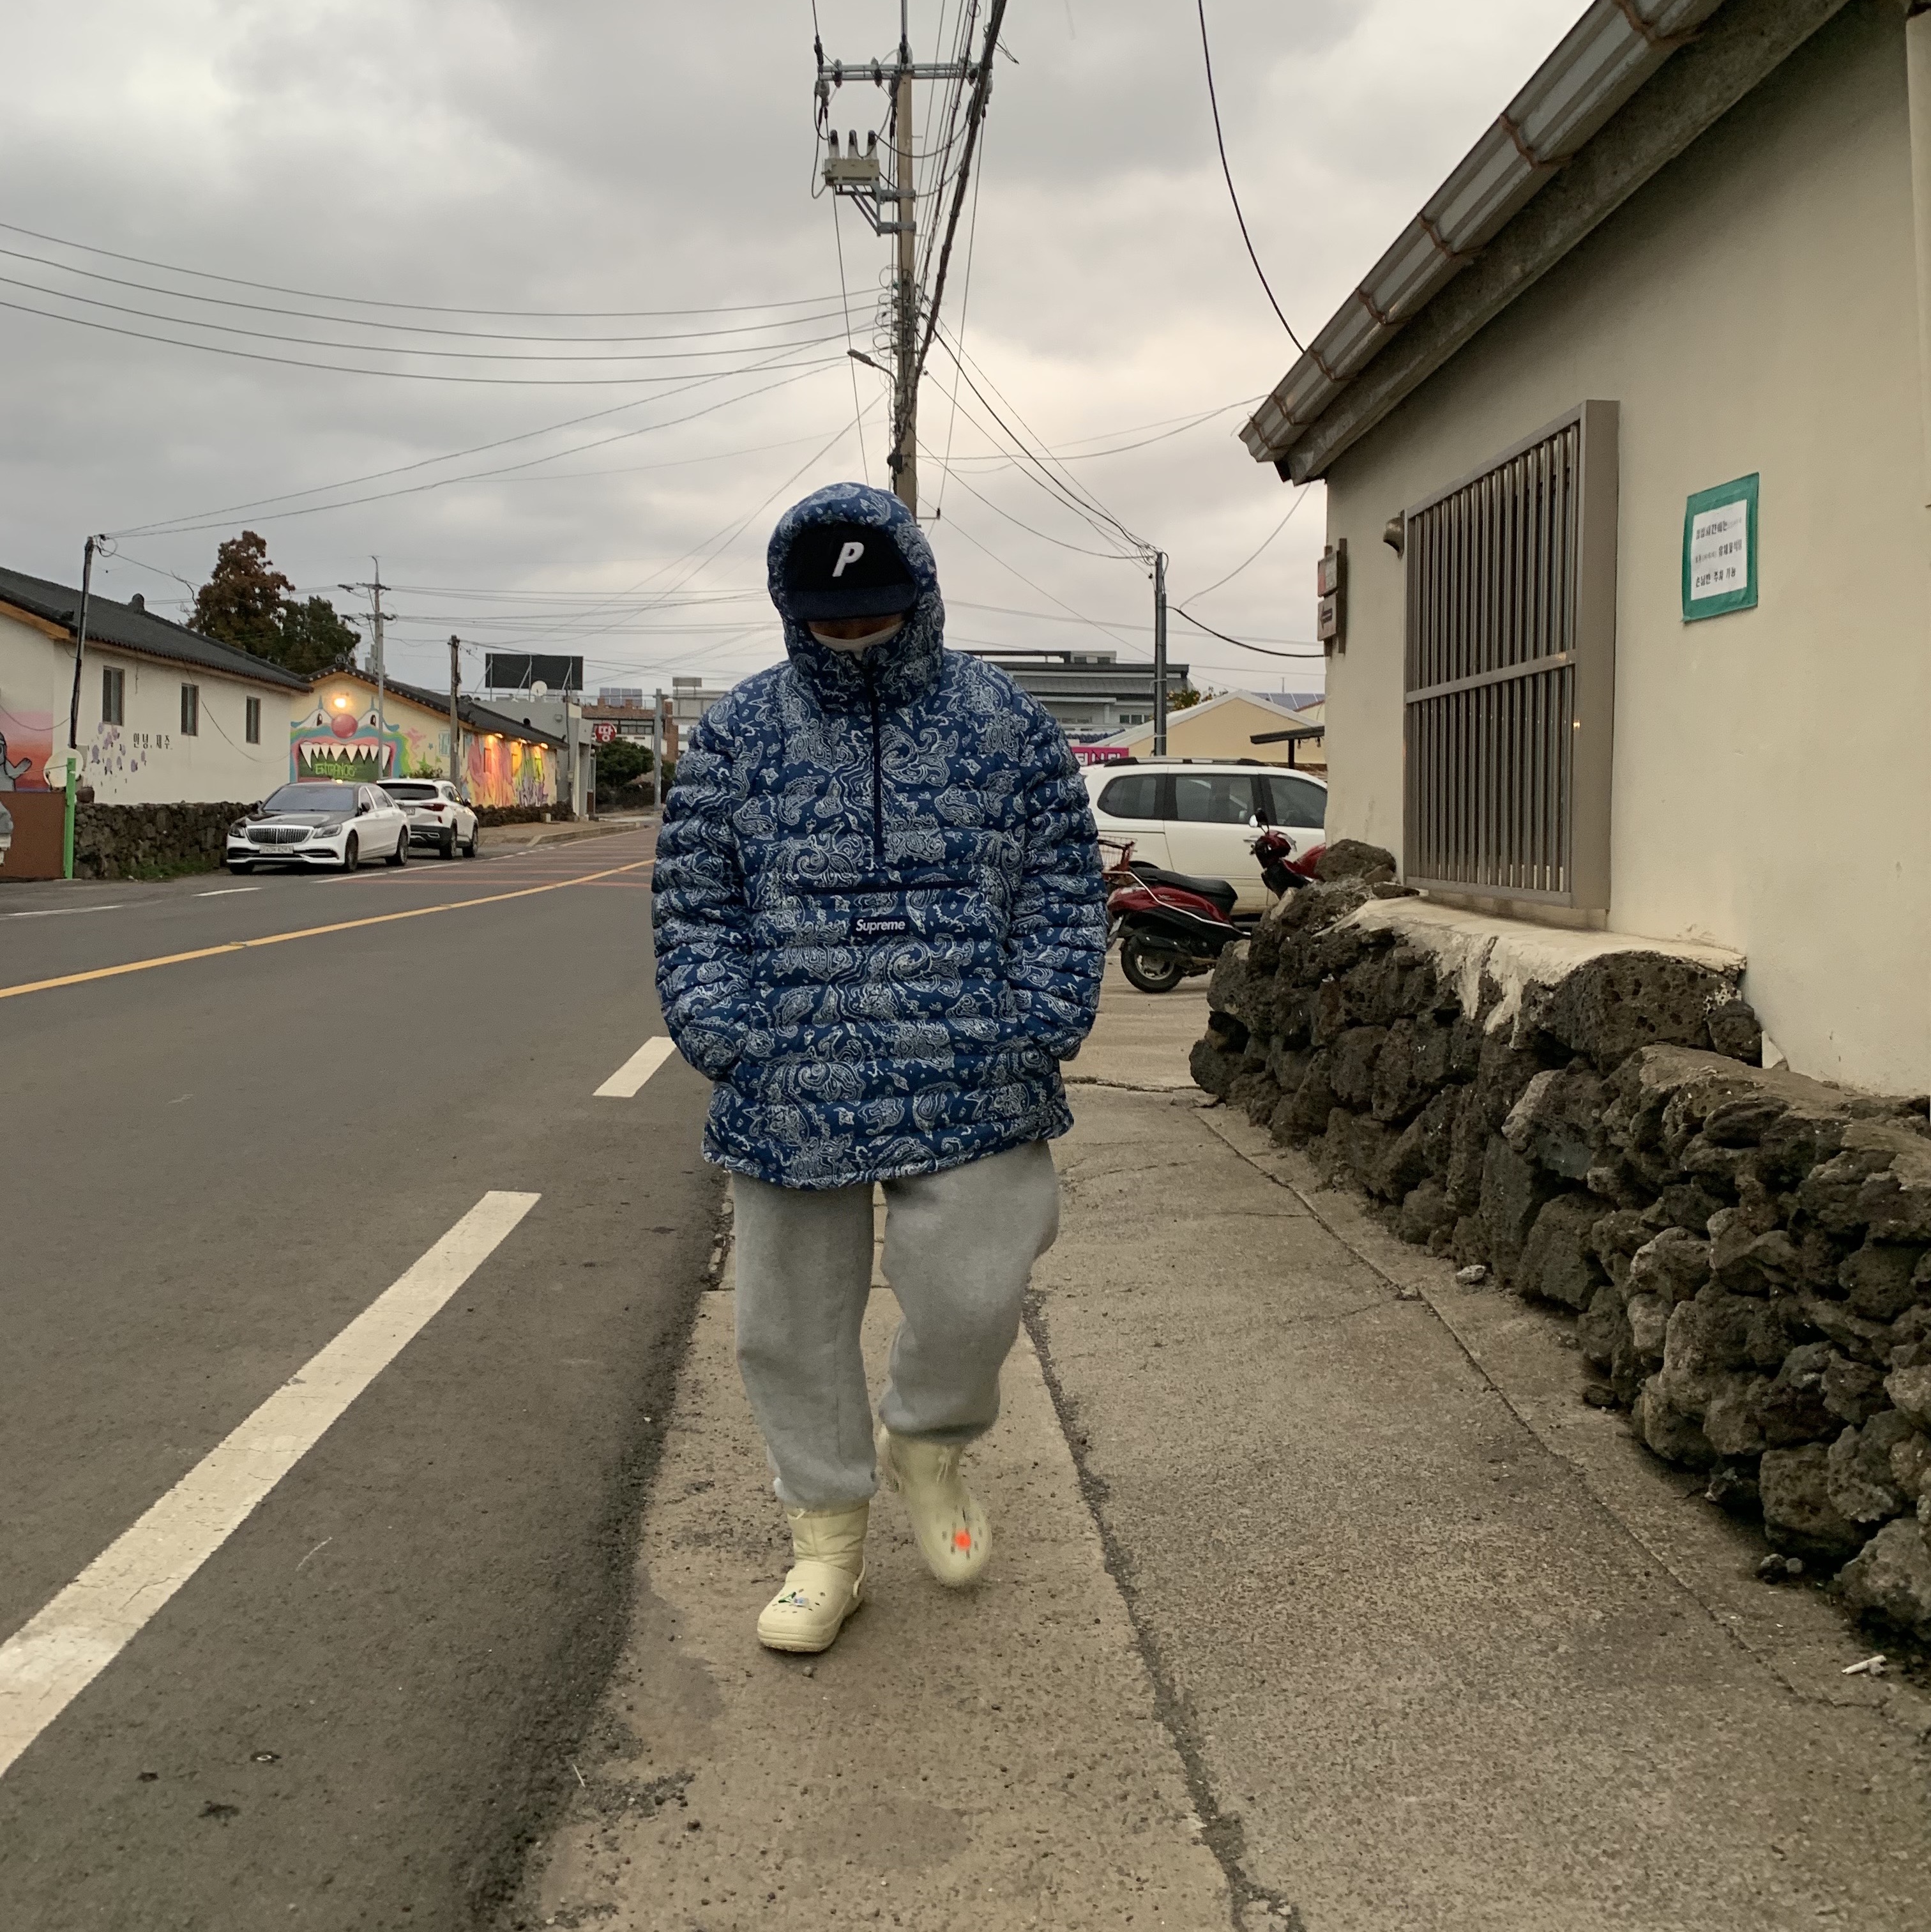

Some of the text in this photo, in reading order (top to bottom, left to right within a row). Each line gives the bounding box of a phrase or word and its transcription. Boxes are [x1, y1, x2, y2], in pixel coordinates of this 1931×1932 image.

[832, 542, 865, 577] P
[1714, 570, 1723, 582] 주차
[856, 918, 906, 934] Supreme
